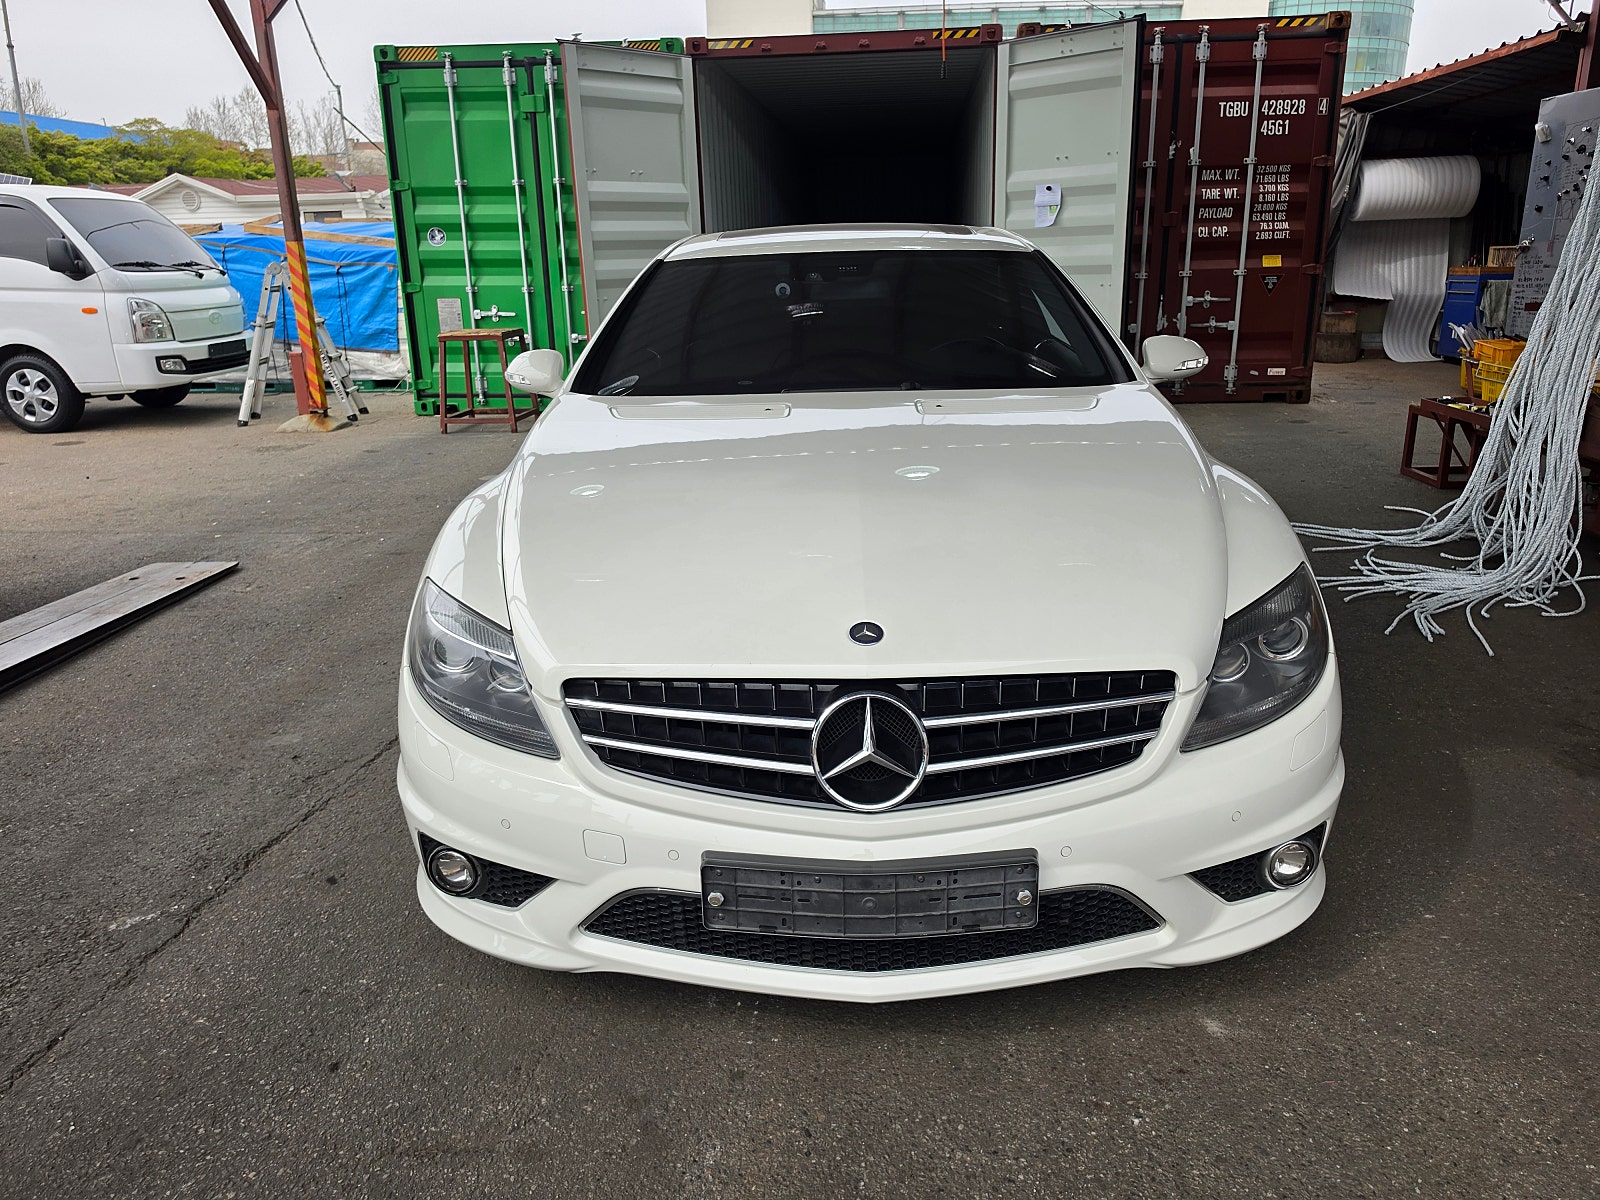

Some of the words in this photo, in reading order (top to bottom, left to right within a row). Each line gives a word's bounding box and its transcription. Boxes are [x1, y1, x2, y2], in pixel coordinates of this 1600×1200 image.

[1219, 102, 1249, 117] TGBU
[1261, 99, 1306, 115] 428928
[1319, 99, 1327, 114] 4
[1260, 120, 1290, 135] 45G1
[1201, 169, 1222, 181] MAX.
[1225, 168, 1240, 180] WT.
[1277, 174, 1290, 183] LBS
[1201, 188, 1221, 200] TARE
[1223, 187, 1240, 199] WT.
[1277, 193, 1290, 201] LBS
[1198, 207, 1233, 219] PAYLOAD
[1275, 203, 1288, 211] KGS
[1274, 212, 1286, 221] LBS
[1198, 226, 1210, 238] CU.
[1212, 225, 1229, 237] CAP.
